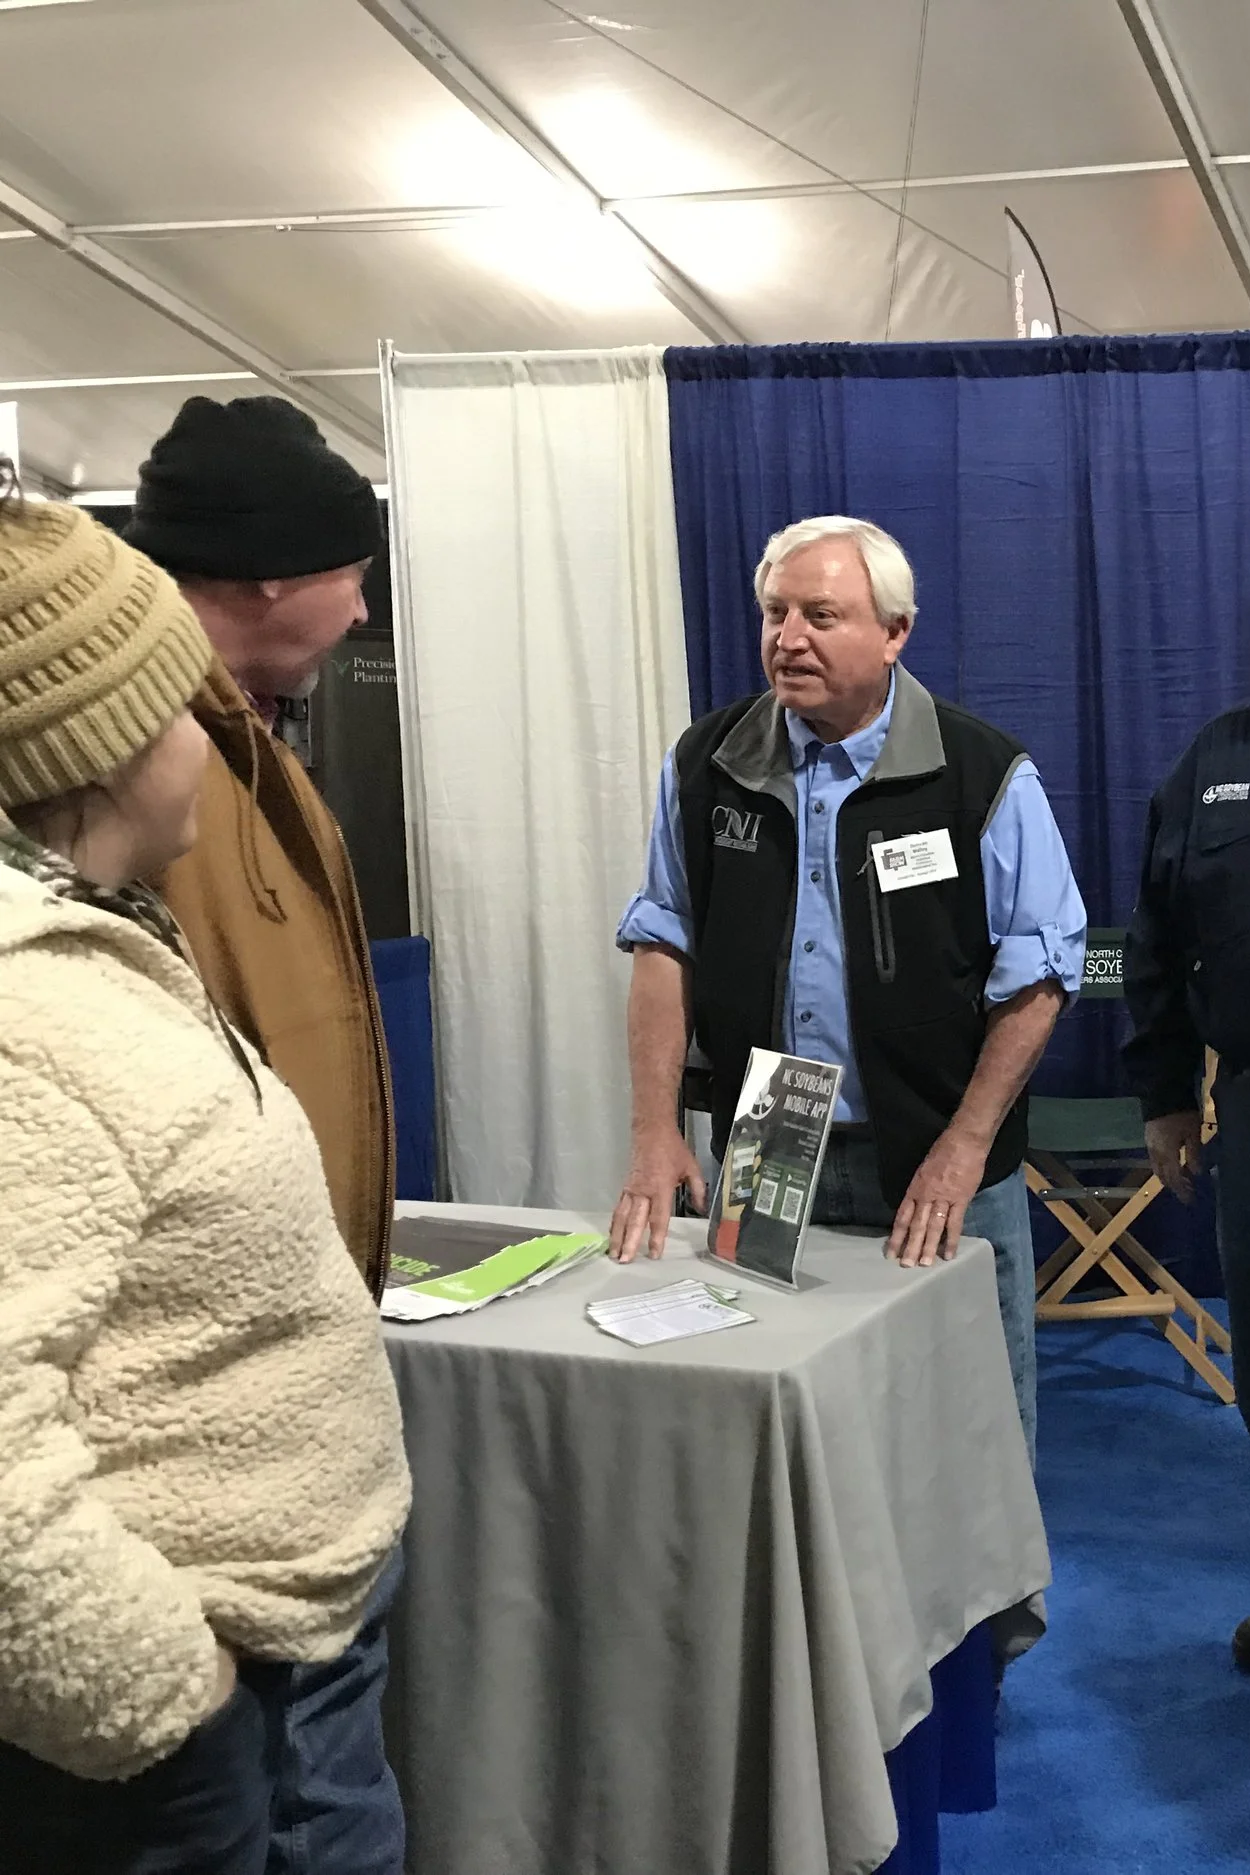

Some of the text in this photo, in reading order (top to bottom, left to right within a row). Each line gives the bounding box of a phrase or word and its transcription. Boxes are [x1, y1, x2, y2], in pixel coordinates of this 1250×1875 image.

[1086, 949, 1115, 958] NORTH
[781, 1068, 833, 1097] NC SOYBEANS
[783, 1093, 829, 1120] MOBILE APP
